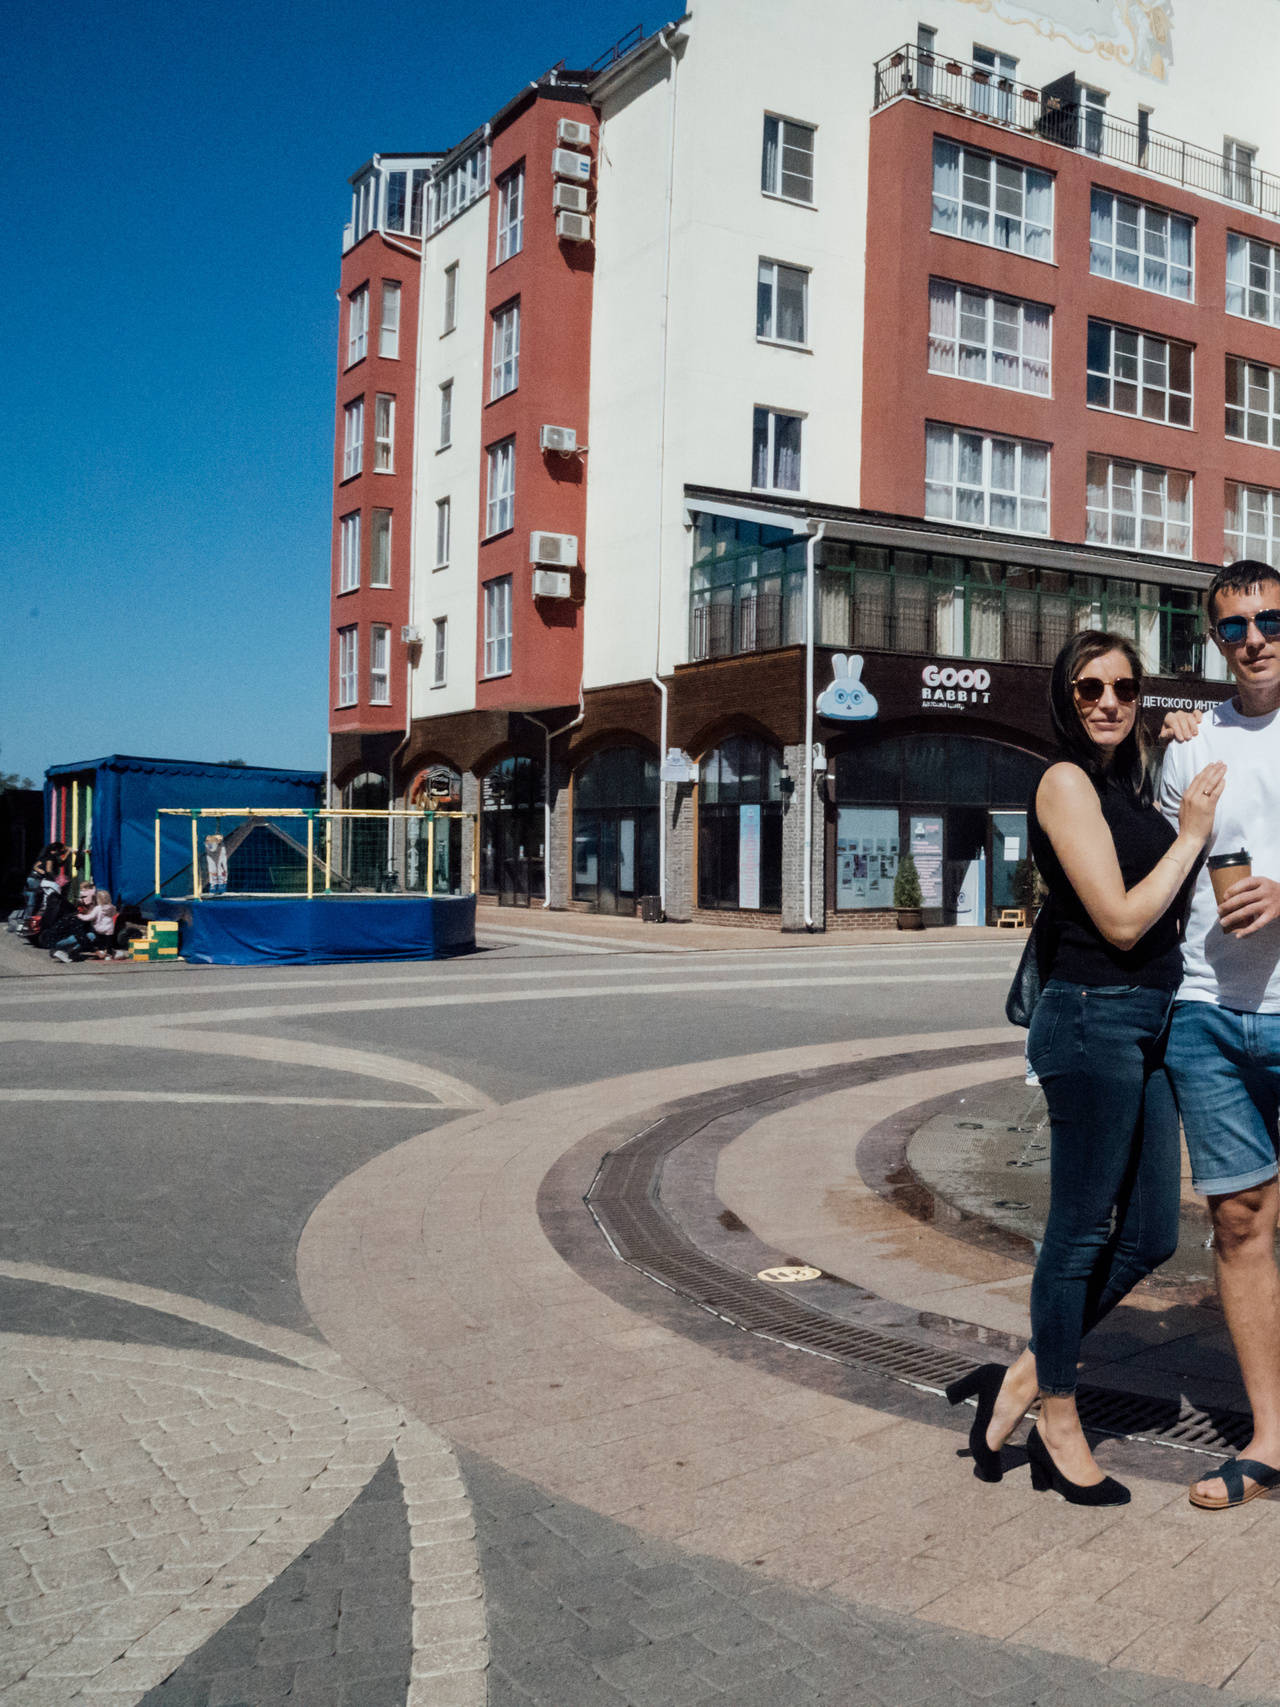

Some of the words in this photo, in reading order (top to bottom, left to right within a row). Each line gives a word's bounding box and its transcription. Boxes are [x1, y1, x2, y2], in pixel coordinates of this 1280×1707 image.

[922, 665, 991, 690] GOOD
[922, 688, 991, 704] RABBIT
[1142, 695, 1193, 710] ДЕТСКОГО
